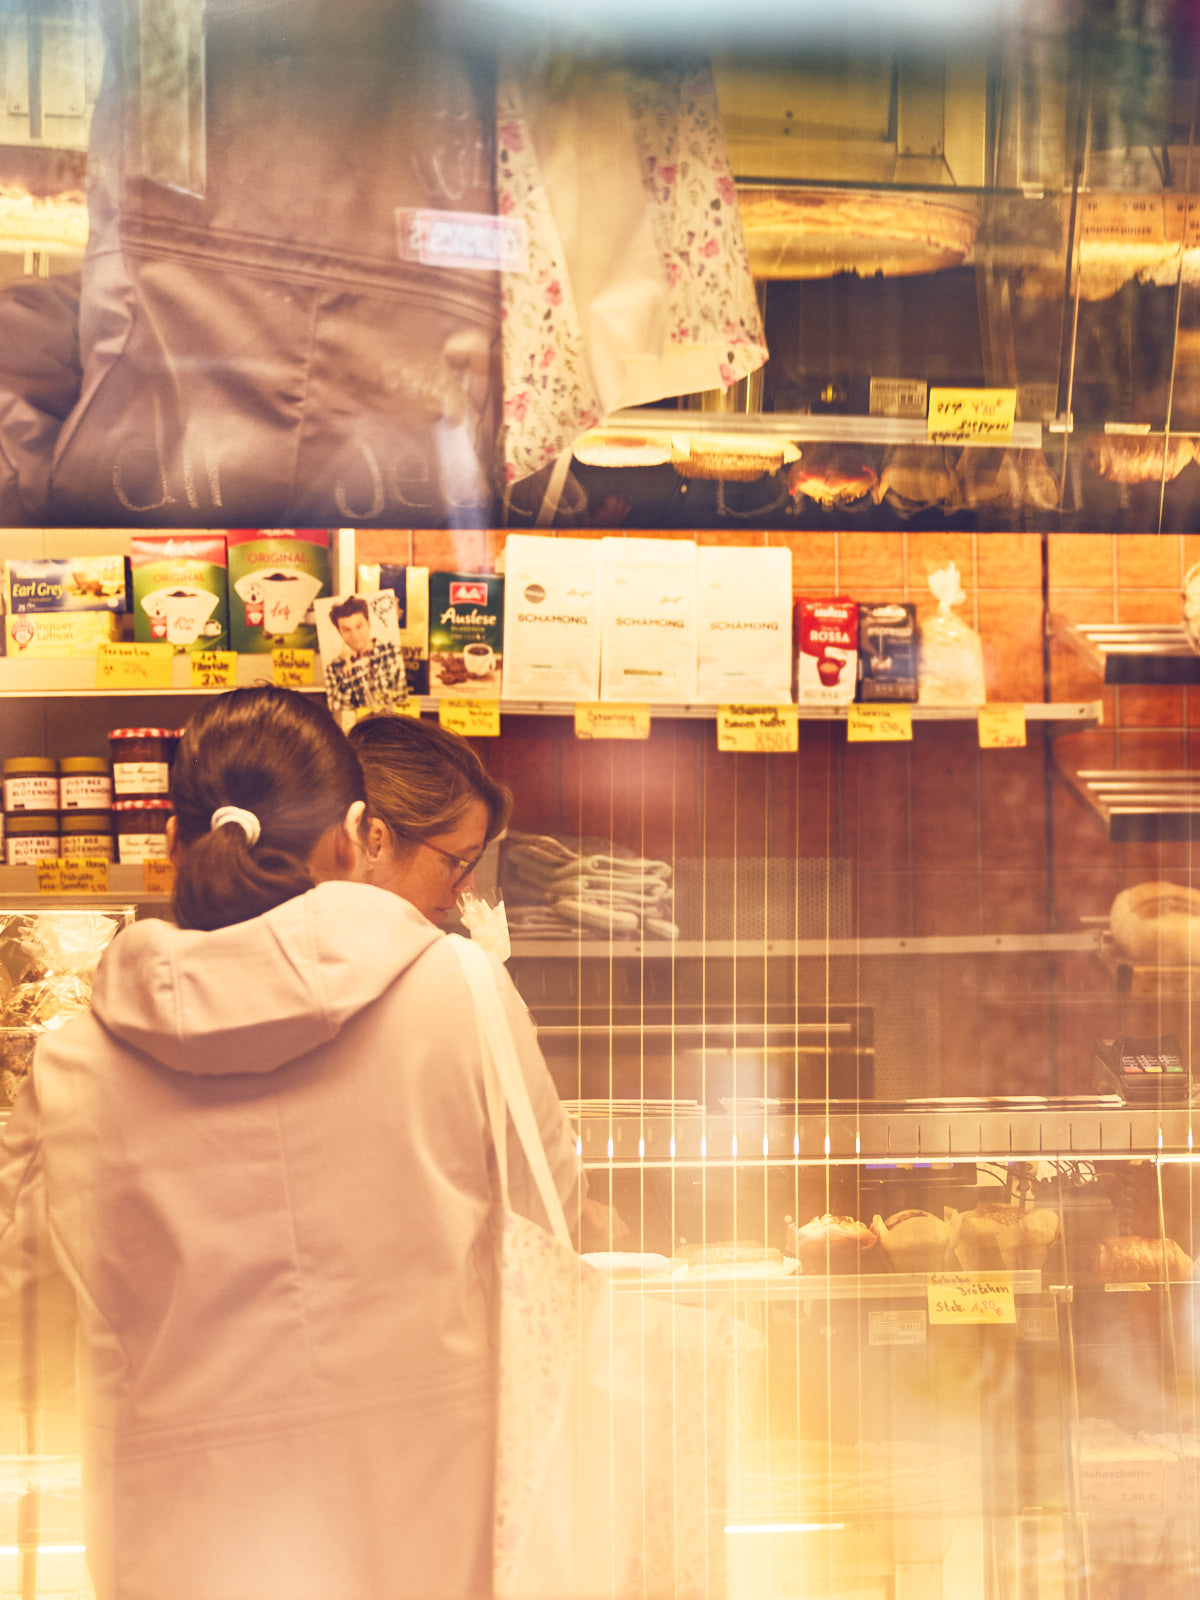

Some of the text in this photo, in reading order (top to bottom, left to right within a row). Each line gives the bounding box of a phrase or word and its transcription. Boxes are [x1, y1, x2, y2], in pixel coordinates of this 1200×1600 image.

[247, 551, 309, 565] ORIGINAL
[153, 573, 206, 583] ORIGINAL
[12, 581, 63, 599] Earl Grey
[440, 607, 497, 626] Auslese
[518, 613, 588, 625] SCHAMONG
[616, 617, 684, 629] SCHAMONG
[711, 620, 778, 631] SCHAMONG
[810, 630, 850, 643] ROSSA
